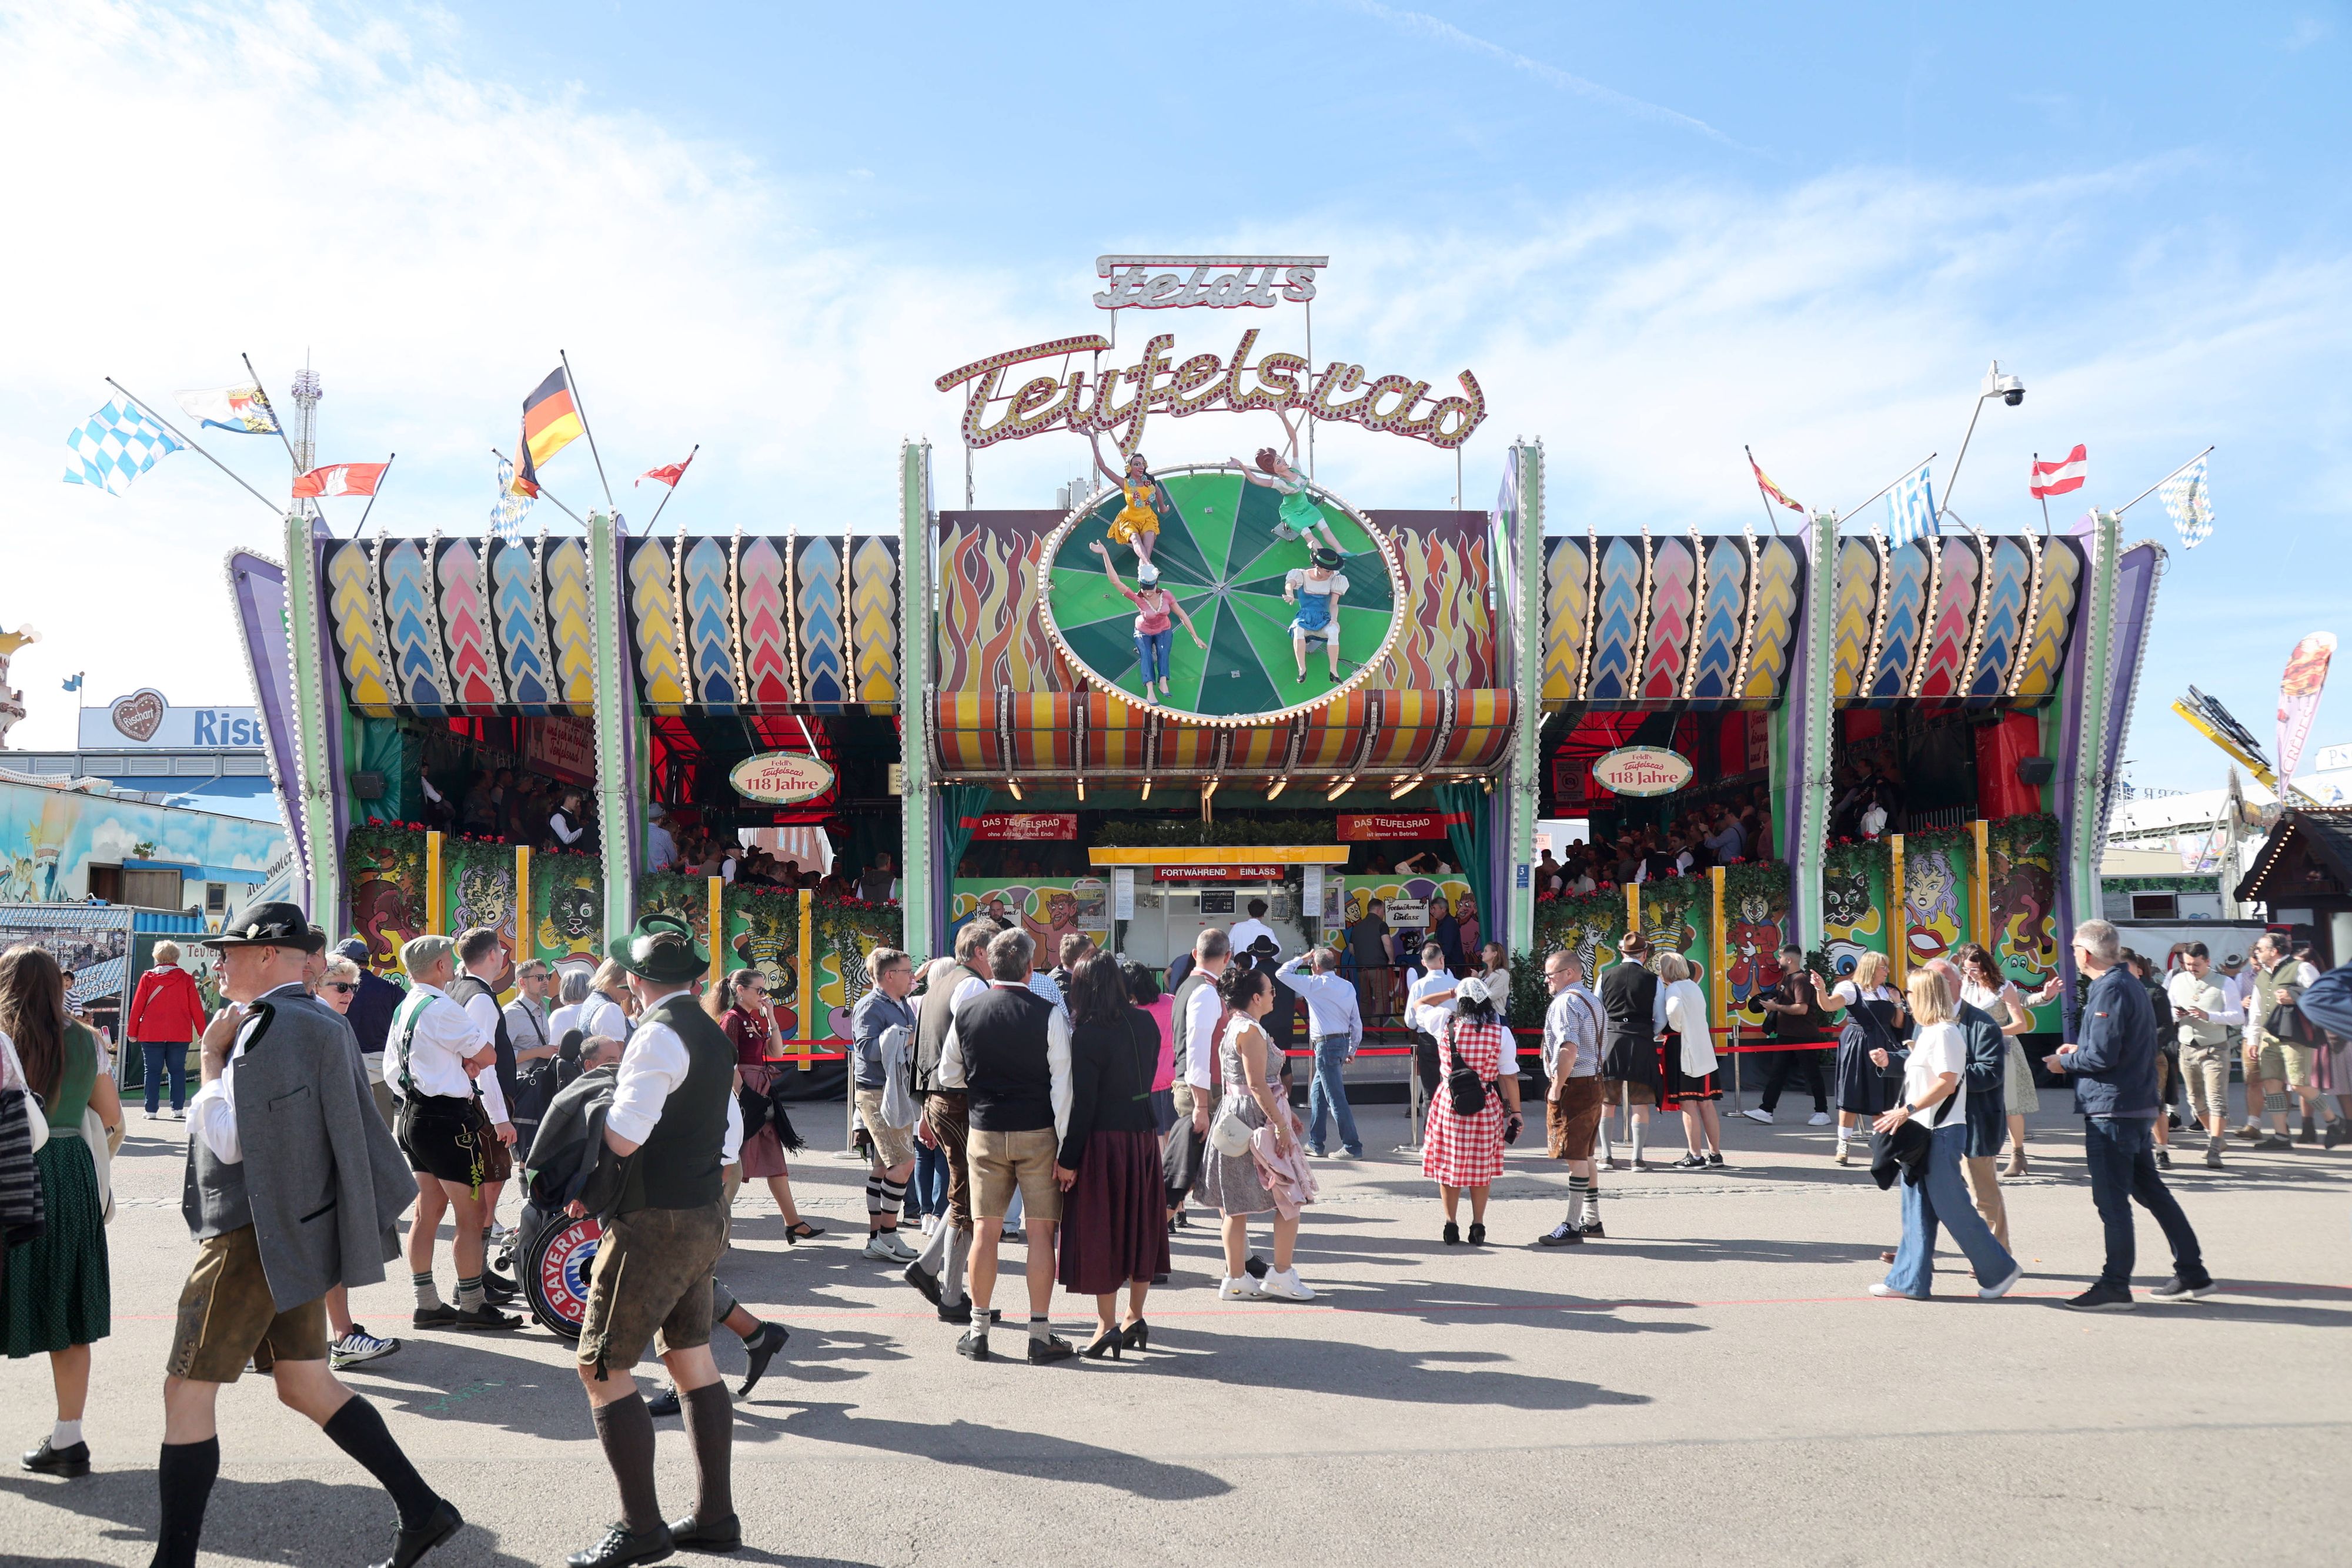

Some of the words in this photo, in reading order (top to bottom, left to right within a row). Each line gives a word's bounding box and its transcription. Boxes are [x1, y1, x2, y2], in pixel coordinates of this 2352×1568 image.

[935, 328, 1488, 457] Teufelsrad
[123, 707, 154, 728] Rischart
[2329, 747, 2352, 765] PS
[761, 767, 804, 777] Teufelsrad
[1623, 761, 1664, 771] Teufelsrad
[746, 778, 771, 790] 118
[775, 777, 818, 792] Jahre
[1608, 772, 1633, 783] 118
[1638, 771, 1678, 785] Jahre
[982, 818, 1001, 828] DAS
[1004, 818, 1060, 828] TEUFELSRAD
[1354, 818, 1372, 828] DAS
[1375, 818, 1430, 828] TEUFELSRAD
[1161, 867, 1227, 876] FORTWÄHREND
[1393, 912, 1419, 921] Einlass
[74, 970, 102, 987] hner
[78, 978, 116, 998] cooter
[546, 1226, 585, 1306] BAYERN
